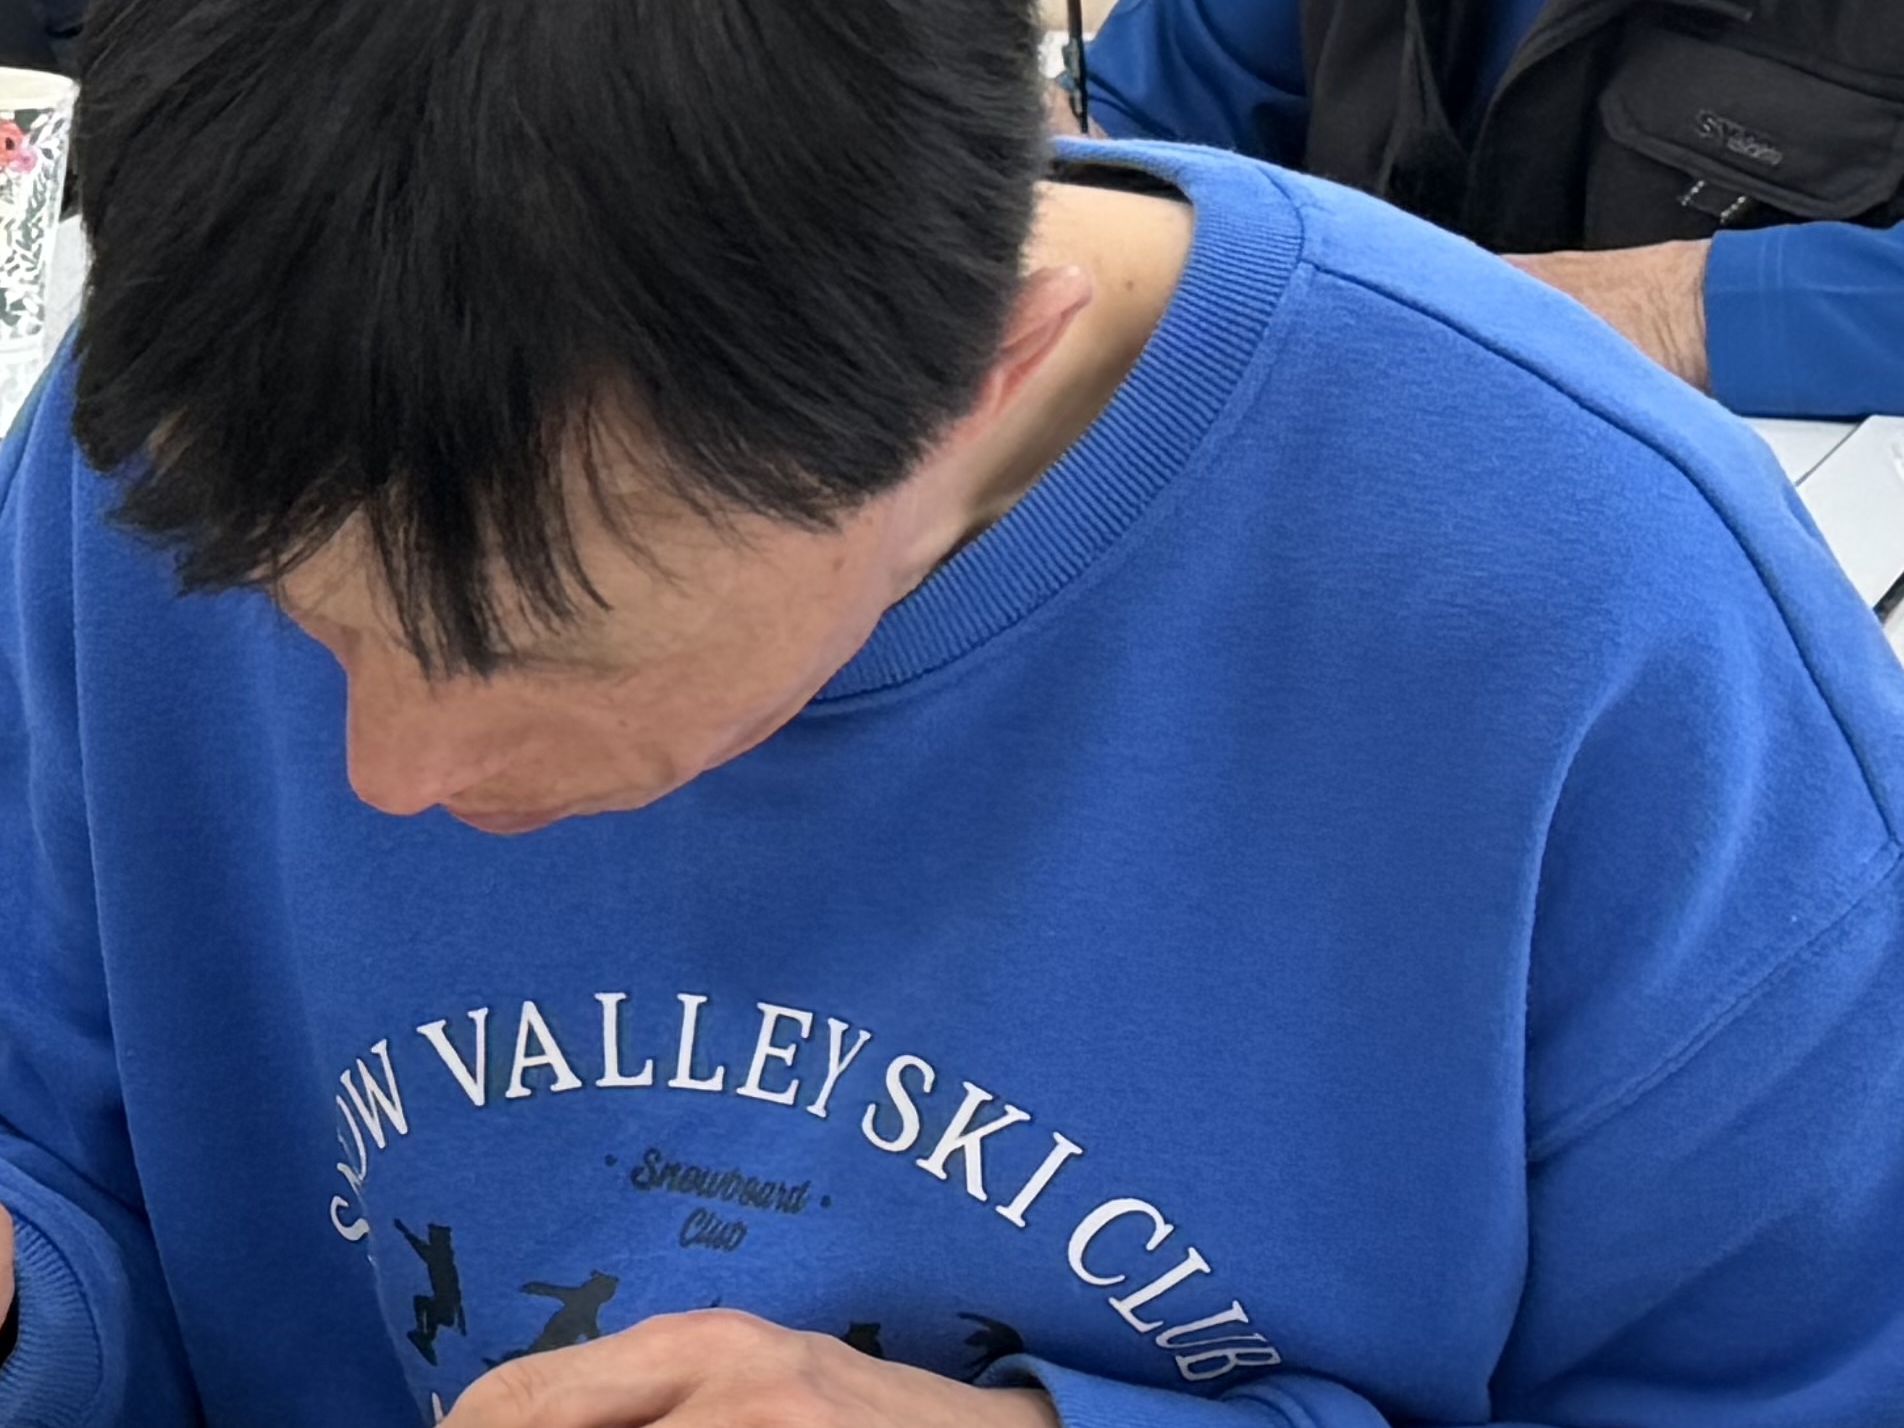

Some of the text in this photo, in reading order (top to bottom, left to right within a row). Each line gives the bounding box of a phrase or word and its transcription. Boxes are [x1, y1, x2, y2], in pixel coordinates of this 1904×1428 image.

[416, 991, 872, 1119] VALLEY
[861, 1054, 1084, 1228] SKI
[1067, 1197, 1282, 1382] CLUB
